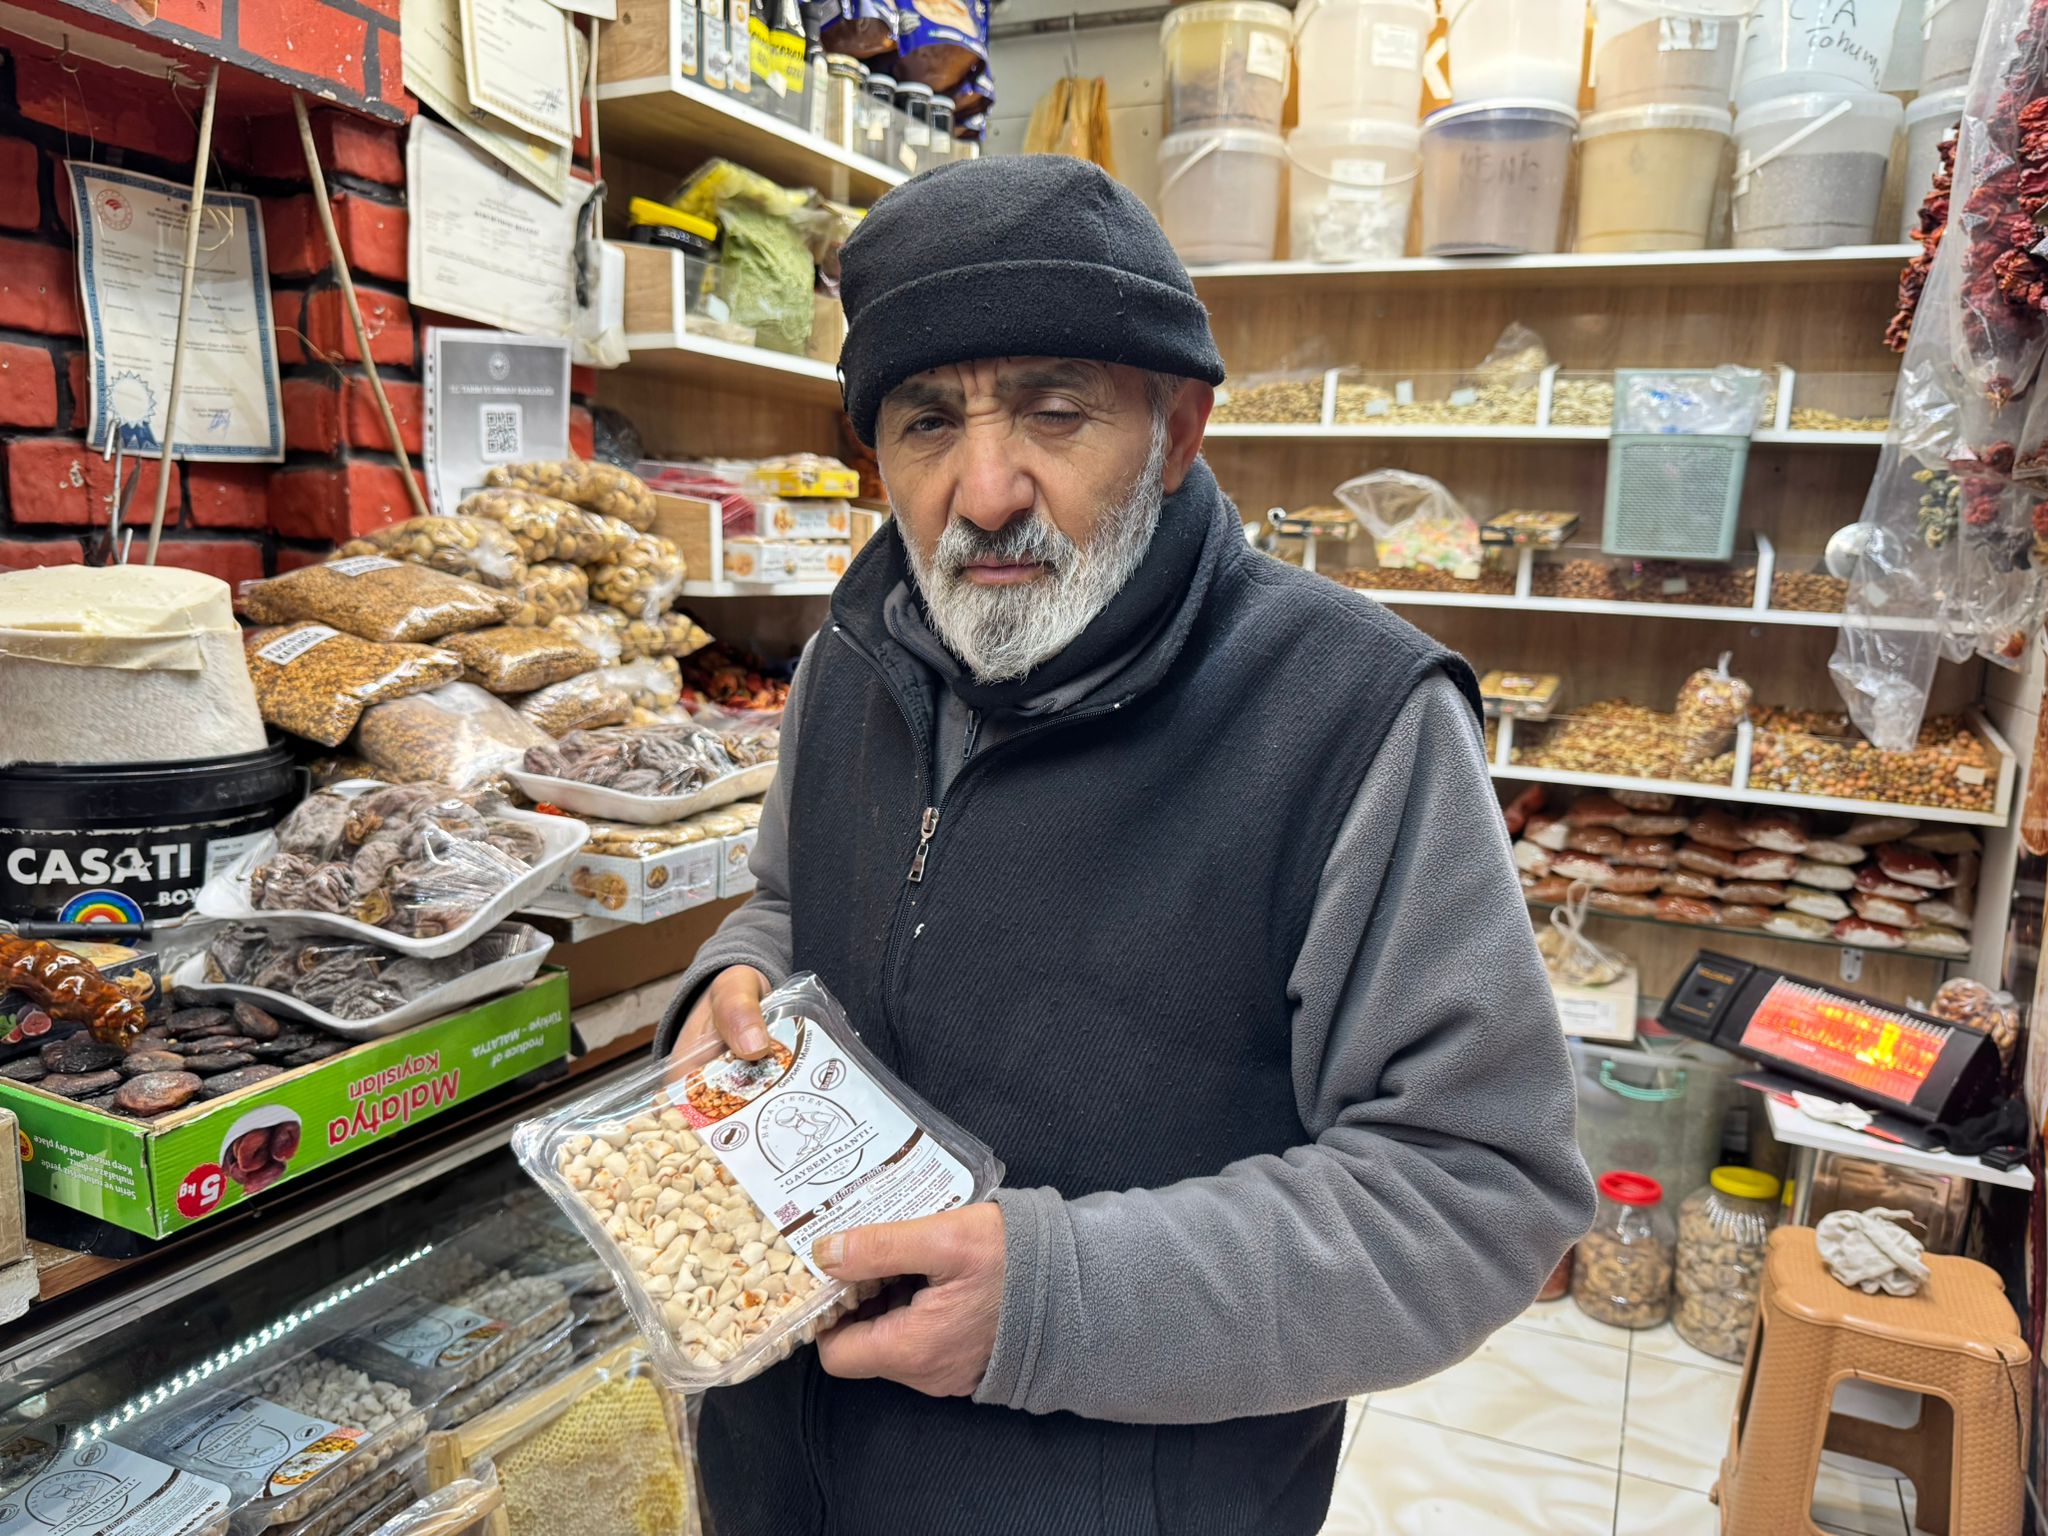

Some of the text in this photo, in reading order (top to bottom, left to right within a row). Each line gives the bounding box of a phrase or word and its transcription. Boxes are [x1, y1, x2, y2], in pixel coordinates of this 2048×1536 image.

[7, 843, 191, 885] CASATI
[472, 1026, 521, 1058] MALATYA
[491, 1034, 544, 1069] Produce of
[778, 1061, 802, 1088] Gayseri
[328, 1068, 460, 1147] Malatya
[761, 1108, 774, 1139] HALA
[32, 1134, 54, 1147] place
[53, 1140, 69, 1153] dry
[68, 1147, 84, 1158] and
[110, 1160, 134, 1175] Keep
[785, 1153, 832, 1186] GAYSERİ
[834, 1130, 870, 1157] MANTI
[103, 1181, 114, 1189] ve
[179, 1173, 221, 1207] 5 kg
